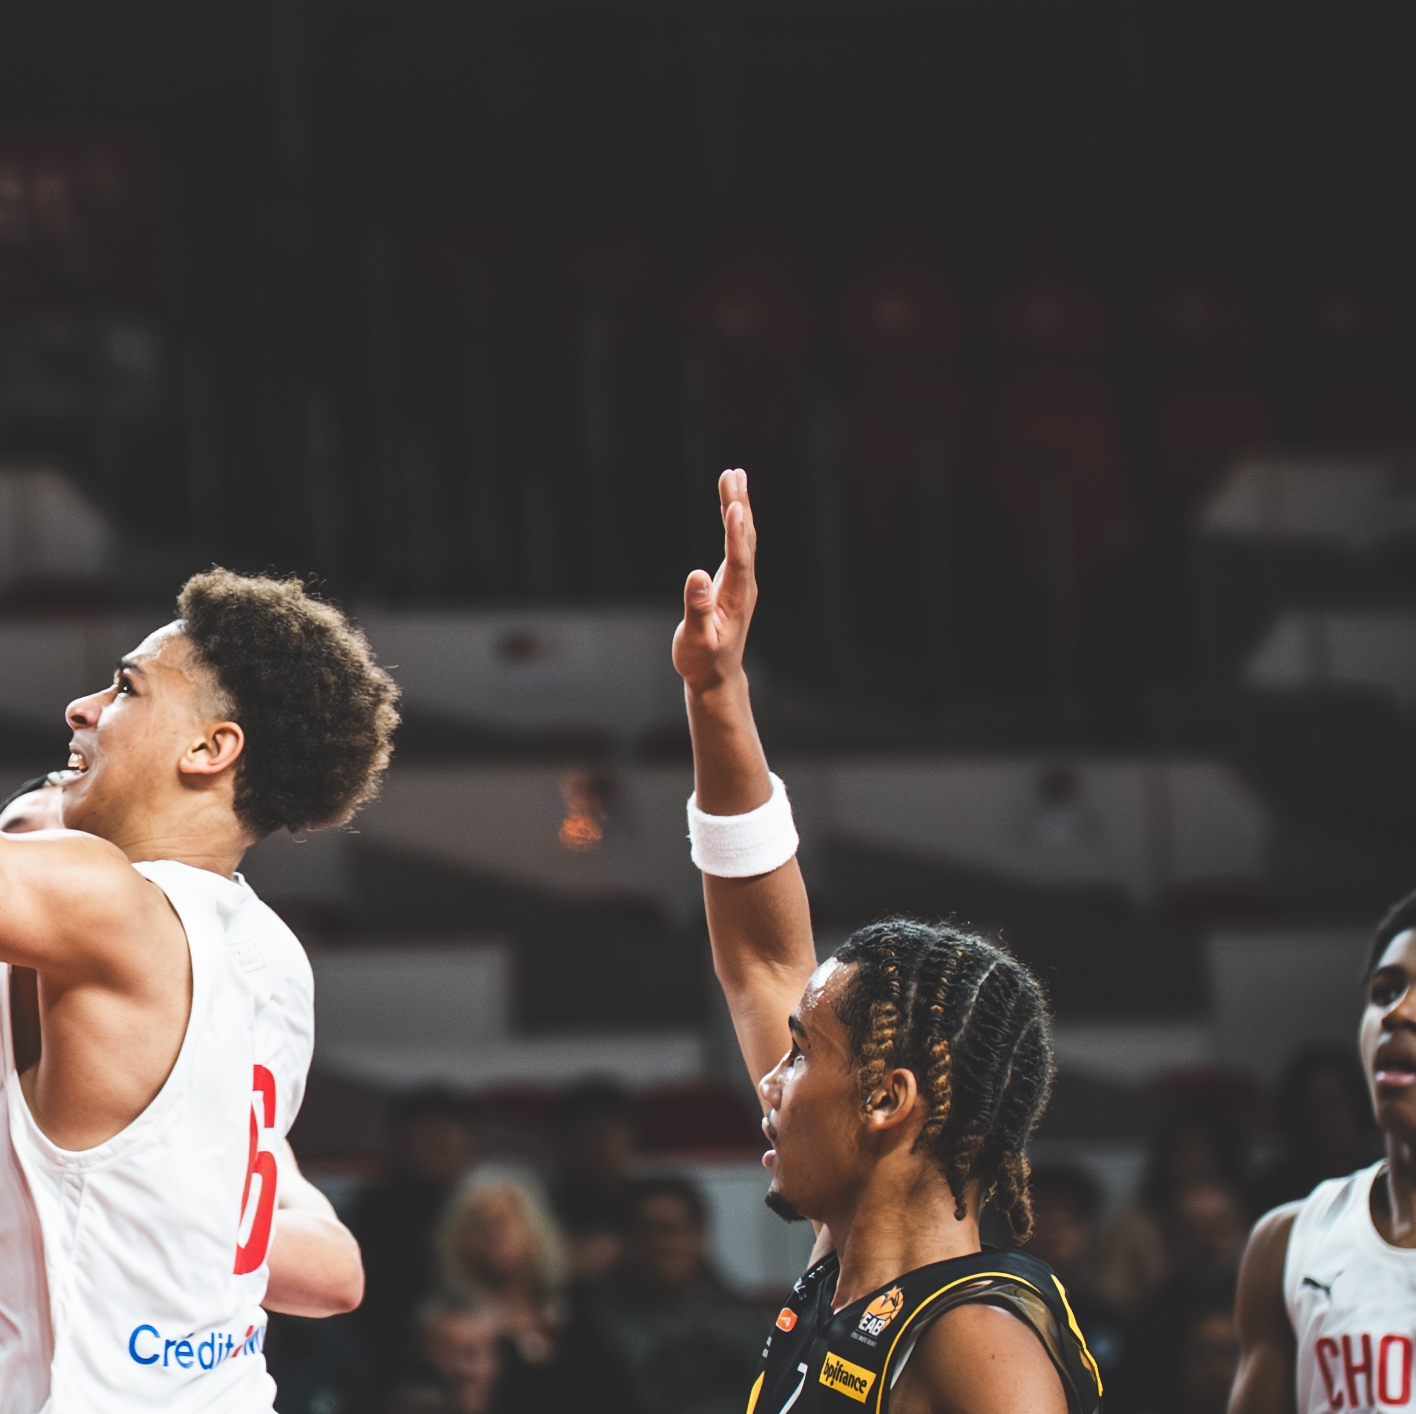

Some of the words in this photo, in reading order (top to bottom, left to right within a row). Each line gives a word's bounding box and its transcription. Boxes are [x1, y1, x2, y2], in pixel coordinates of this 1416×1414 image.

[232, 1063, 278, 1276] 6
[128, 1323, 234, 1371] Crédit
[858, 1312, 887, 1337] EAB
[823, 1357, 868, 1395] bpifrance
[1315, 1333, 1413, 1409] CHO
